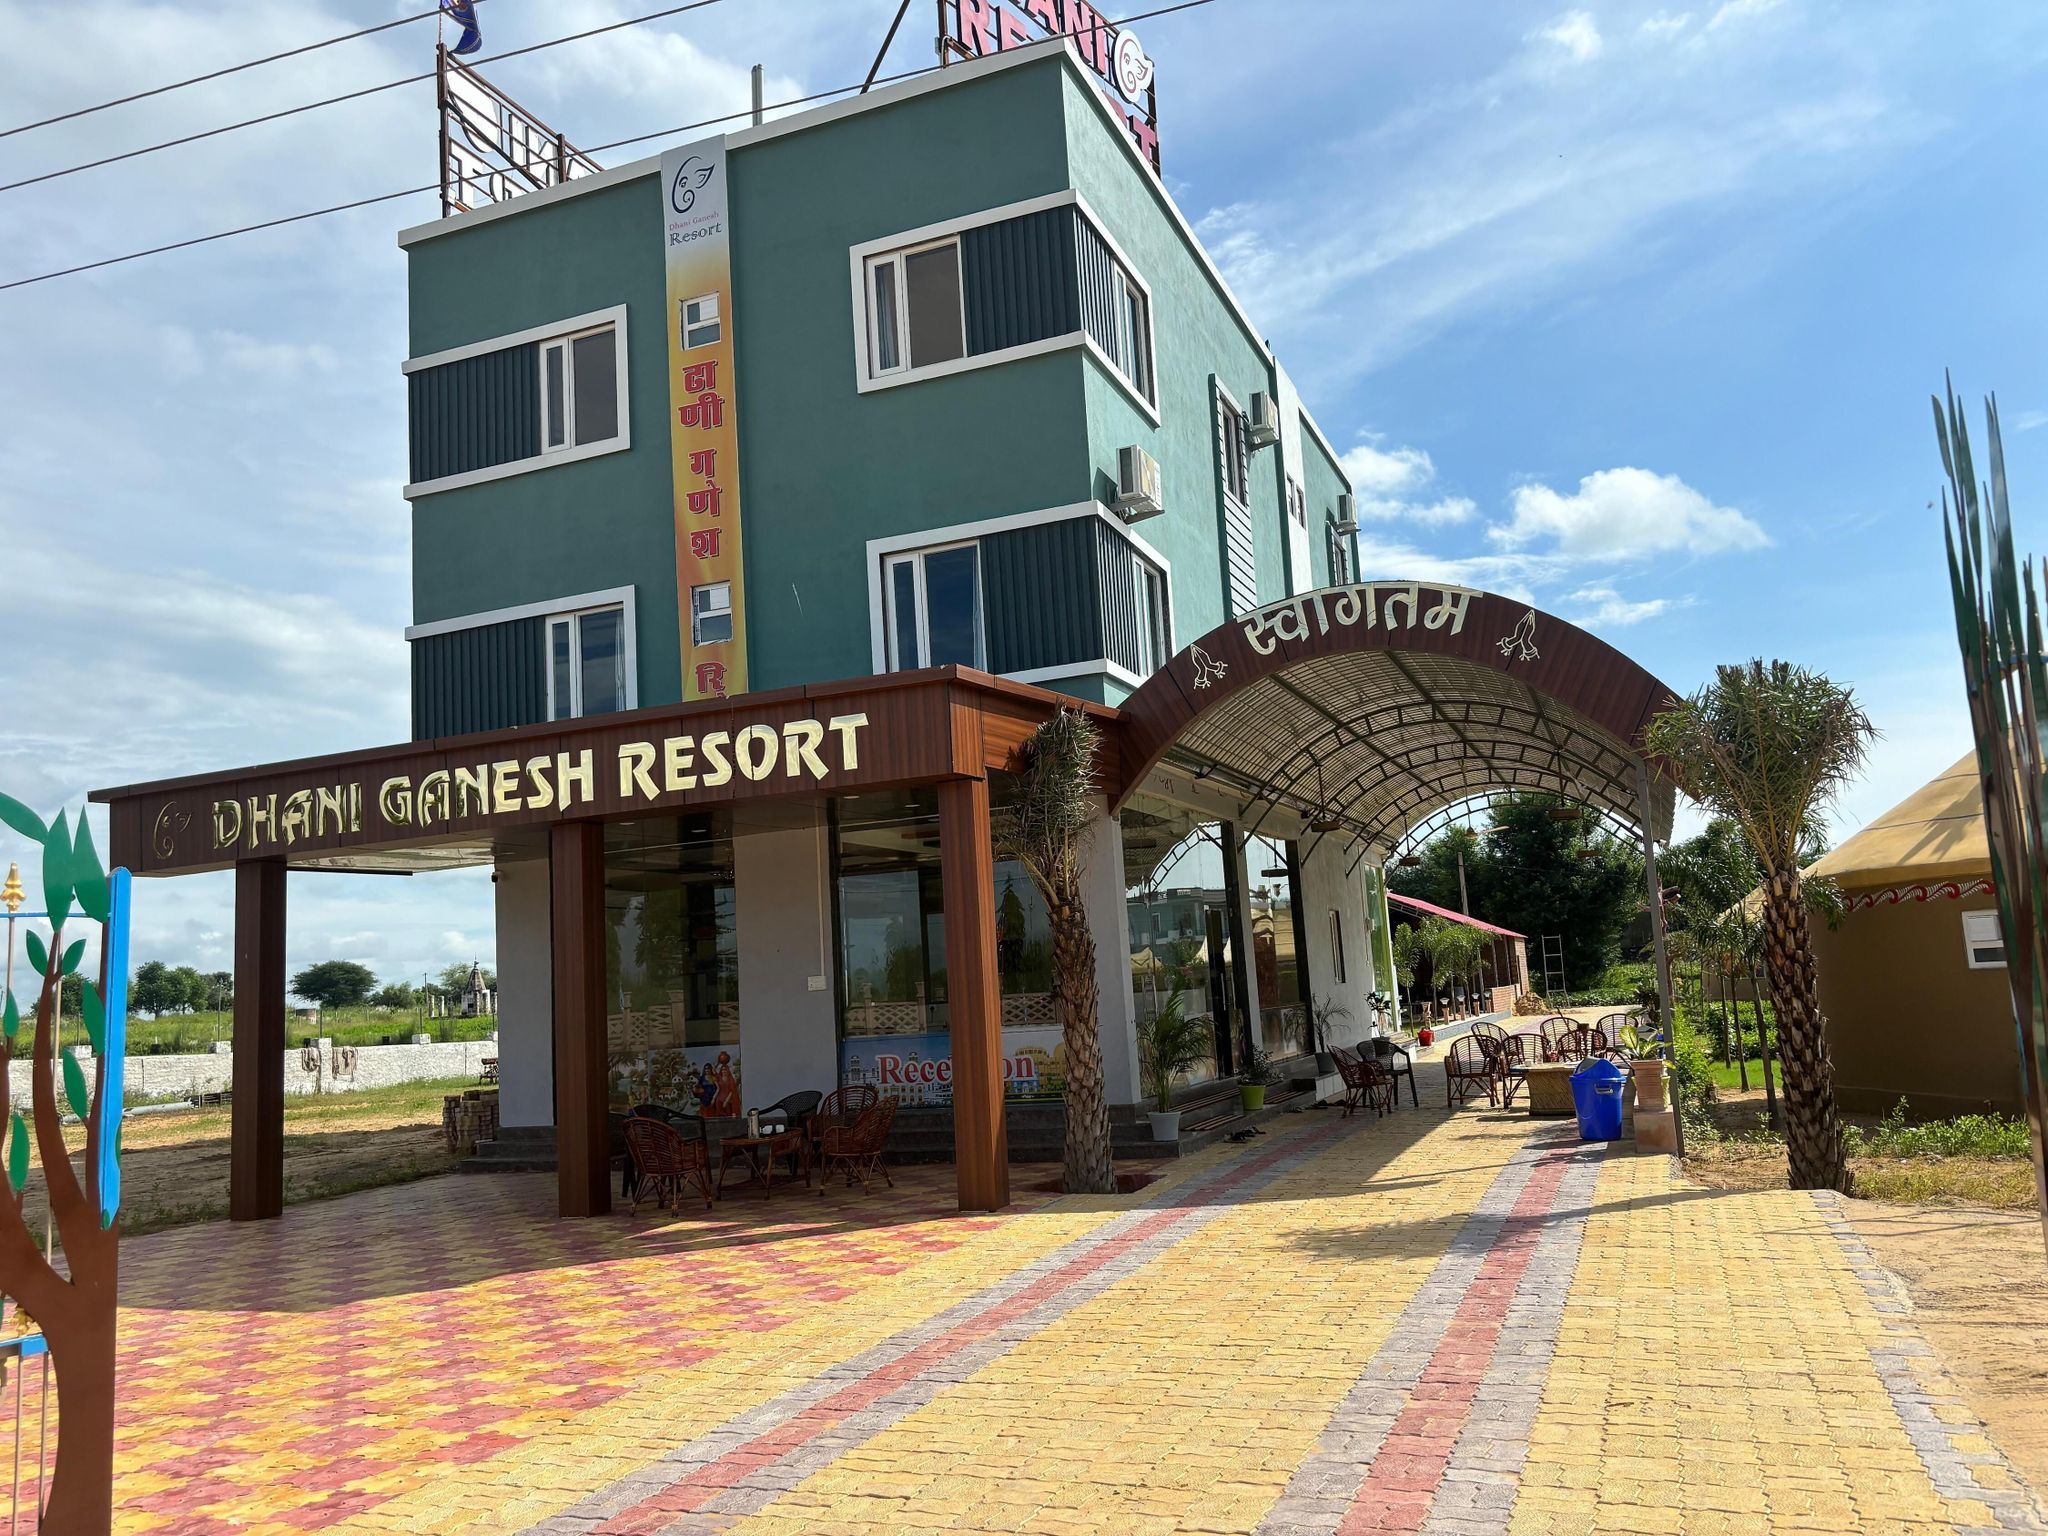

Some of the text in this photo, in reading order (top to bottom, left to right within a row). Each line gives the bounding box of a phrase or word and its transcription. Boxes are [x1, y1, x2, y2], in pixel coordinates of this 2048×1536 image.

[692, 211, 720, 226] Ganesh
[669, 222, 723, 247] Resort
[213, 712, 870, 850] DHANI GANESH RESORT
[877, 1056, 1034, 1084] Receon
